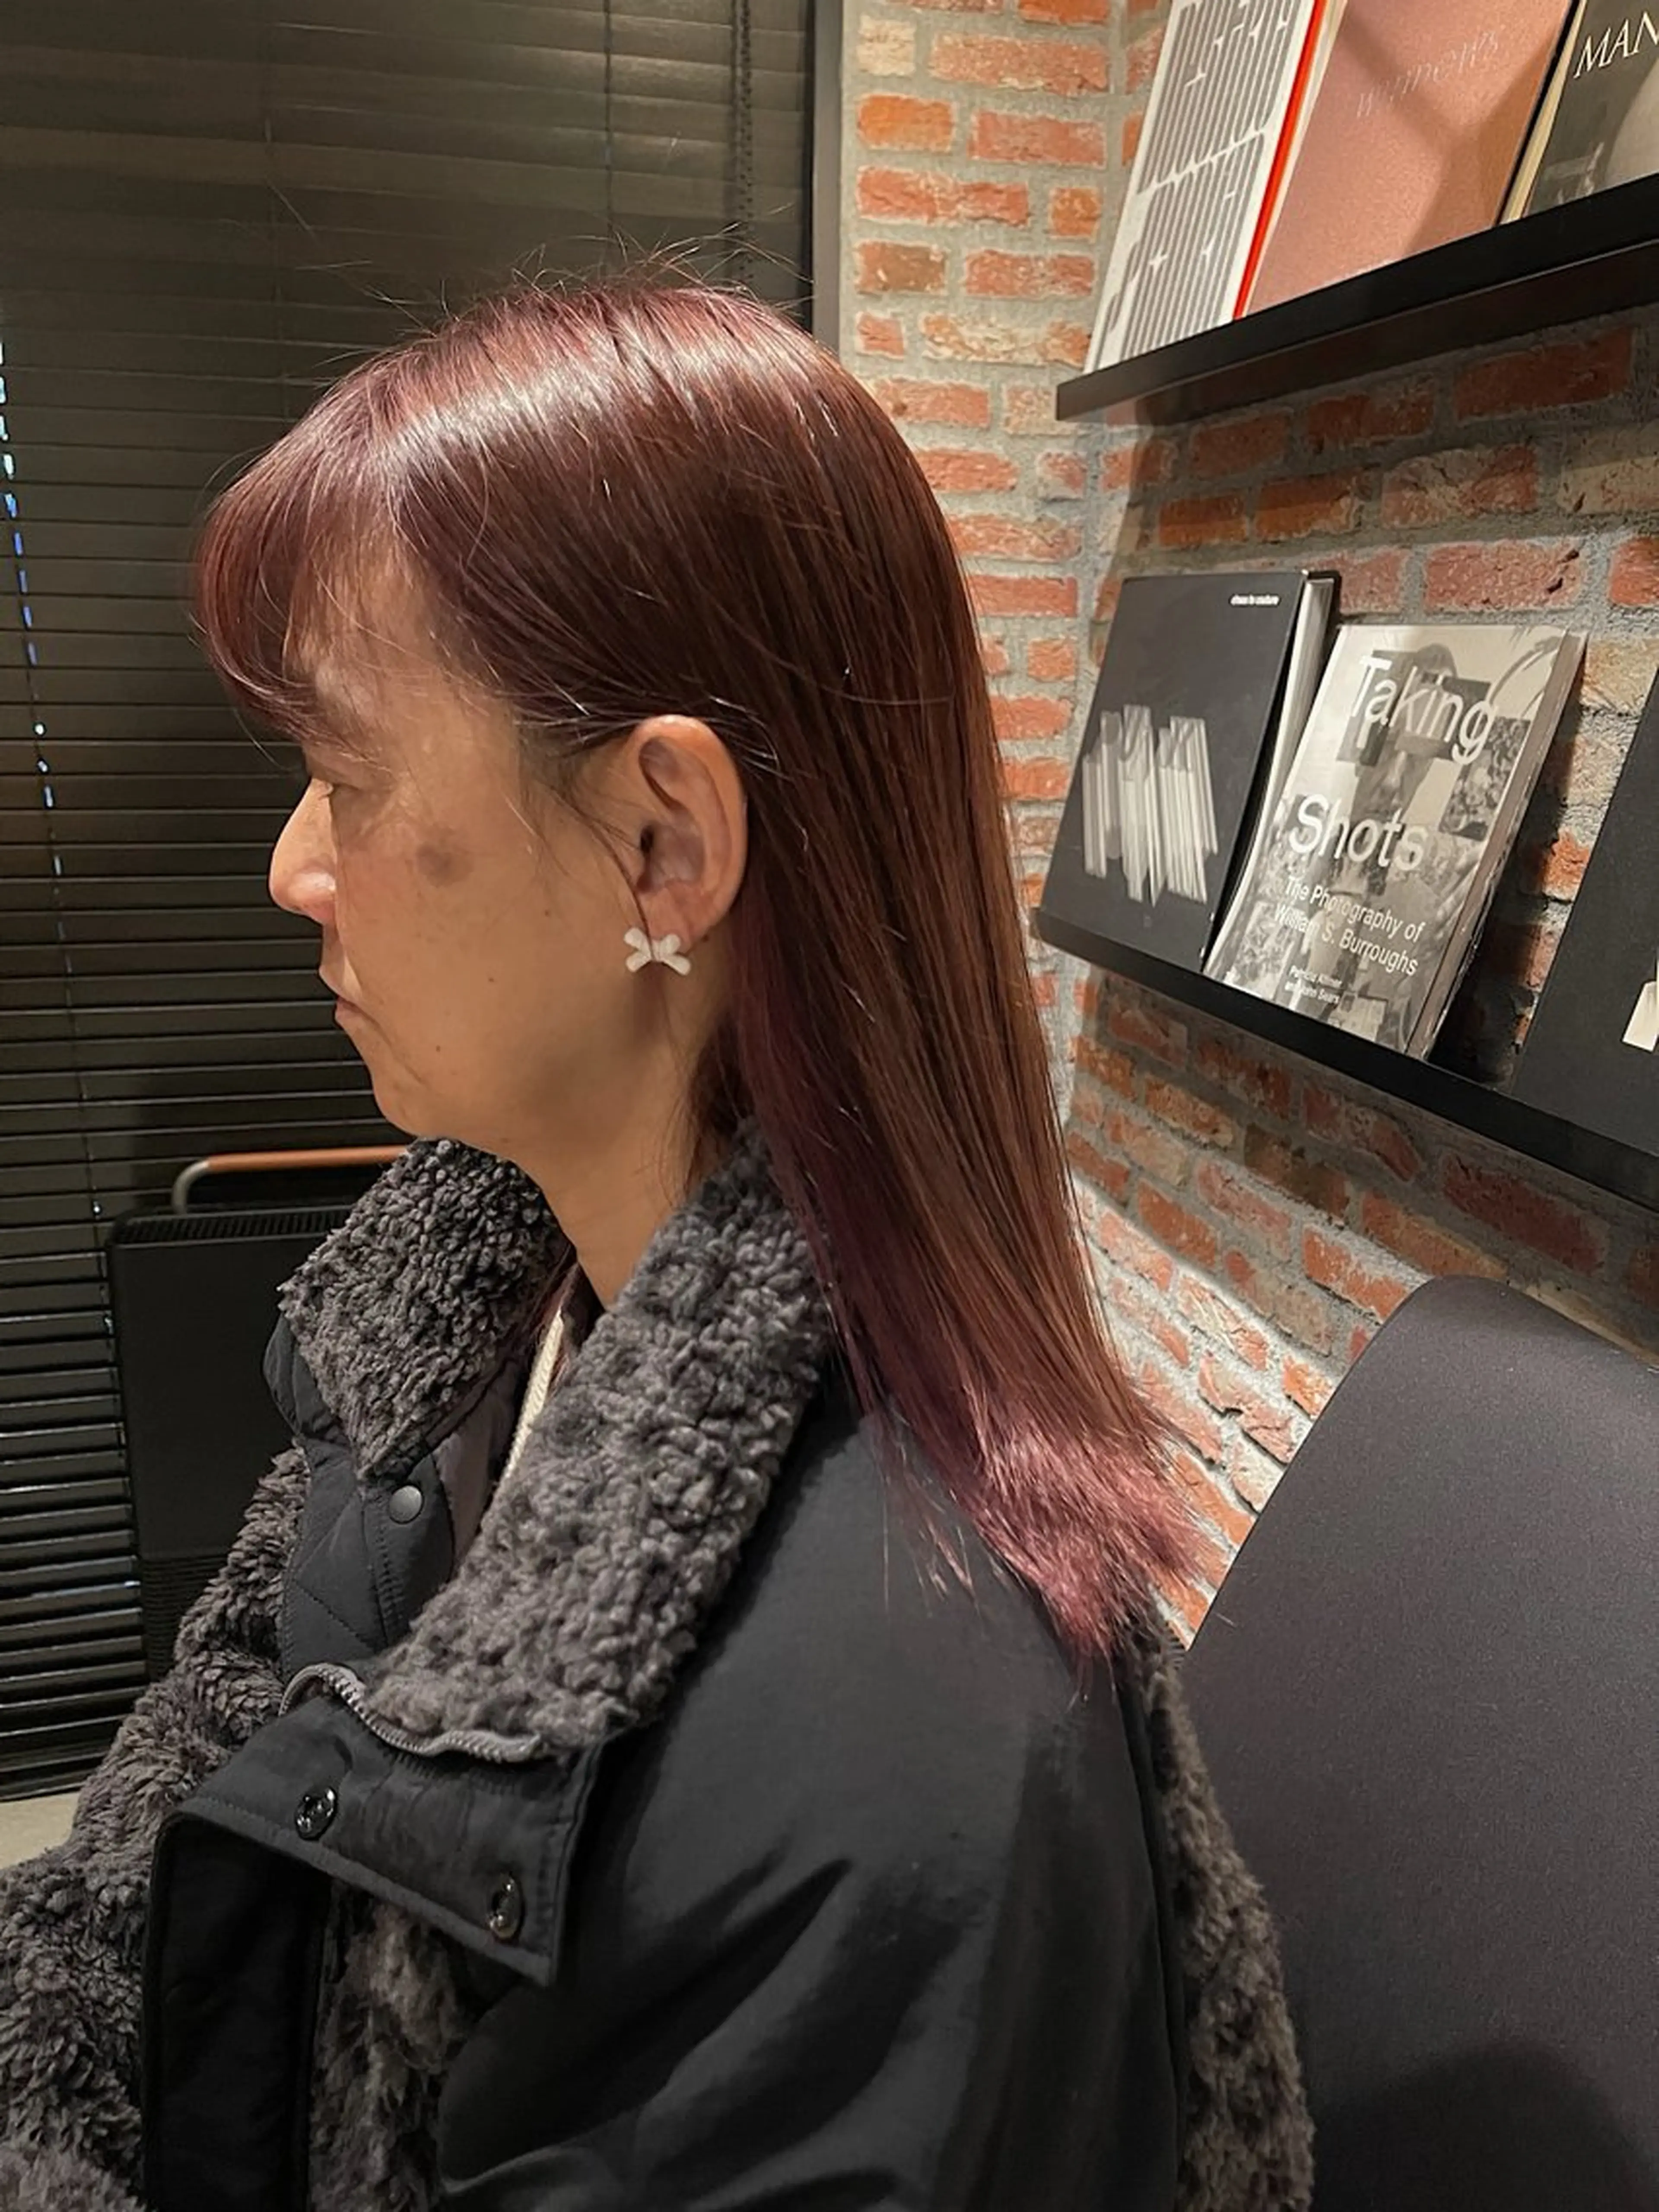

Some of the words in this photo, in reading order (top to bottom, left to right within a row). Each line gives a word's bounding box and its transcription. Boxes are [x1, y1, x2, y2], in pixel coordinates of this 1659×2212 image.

[1352, 655, 1497, 765] Taking
[1289, 794, 1428, 871] Shots
[1286, 875, 1309, 900] The
[1310, 884, 1403, 939] Photography
[1404, 922, 1426, 942] of
[1322, 921, 1335, 944] S.
[1339, 929, 1419, 976] Burroughs
